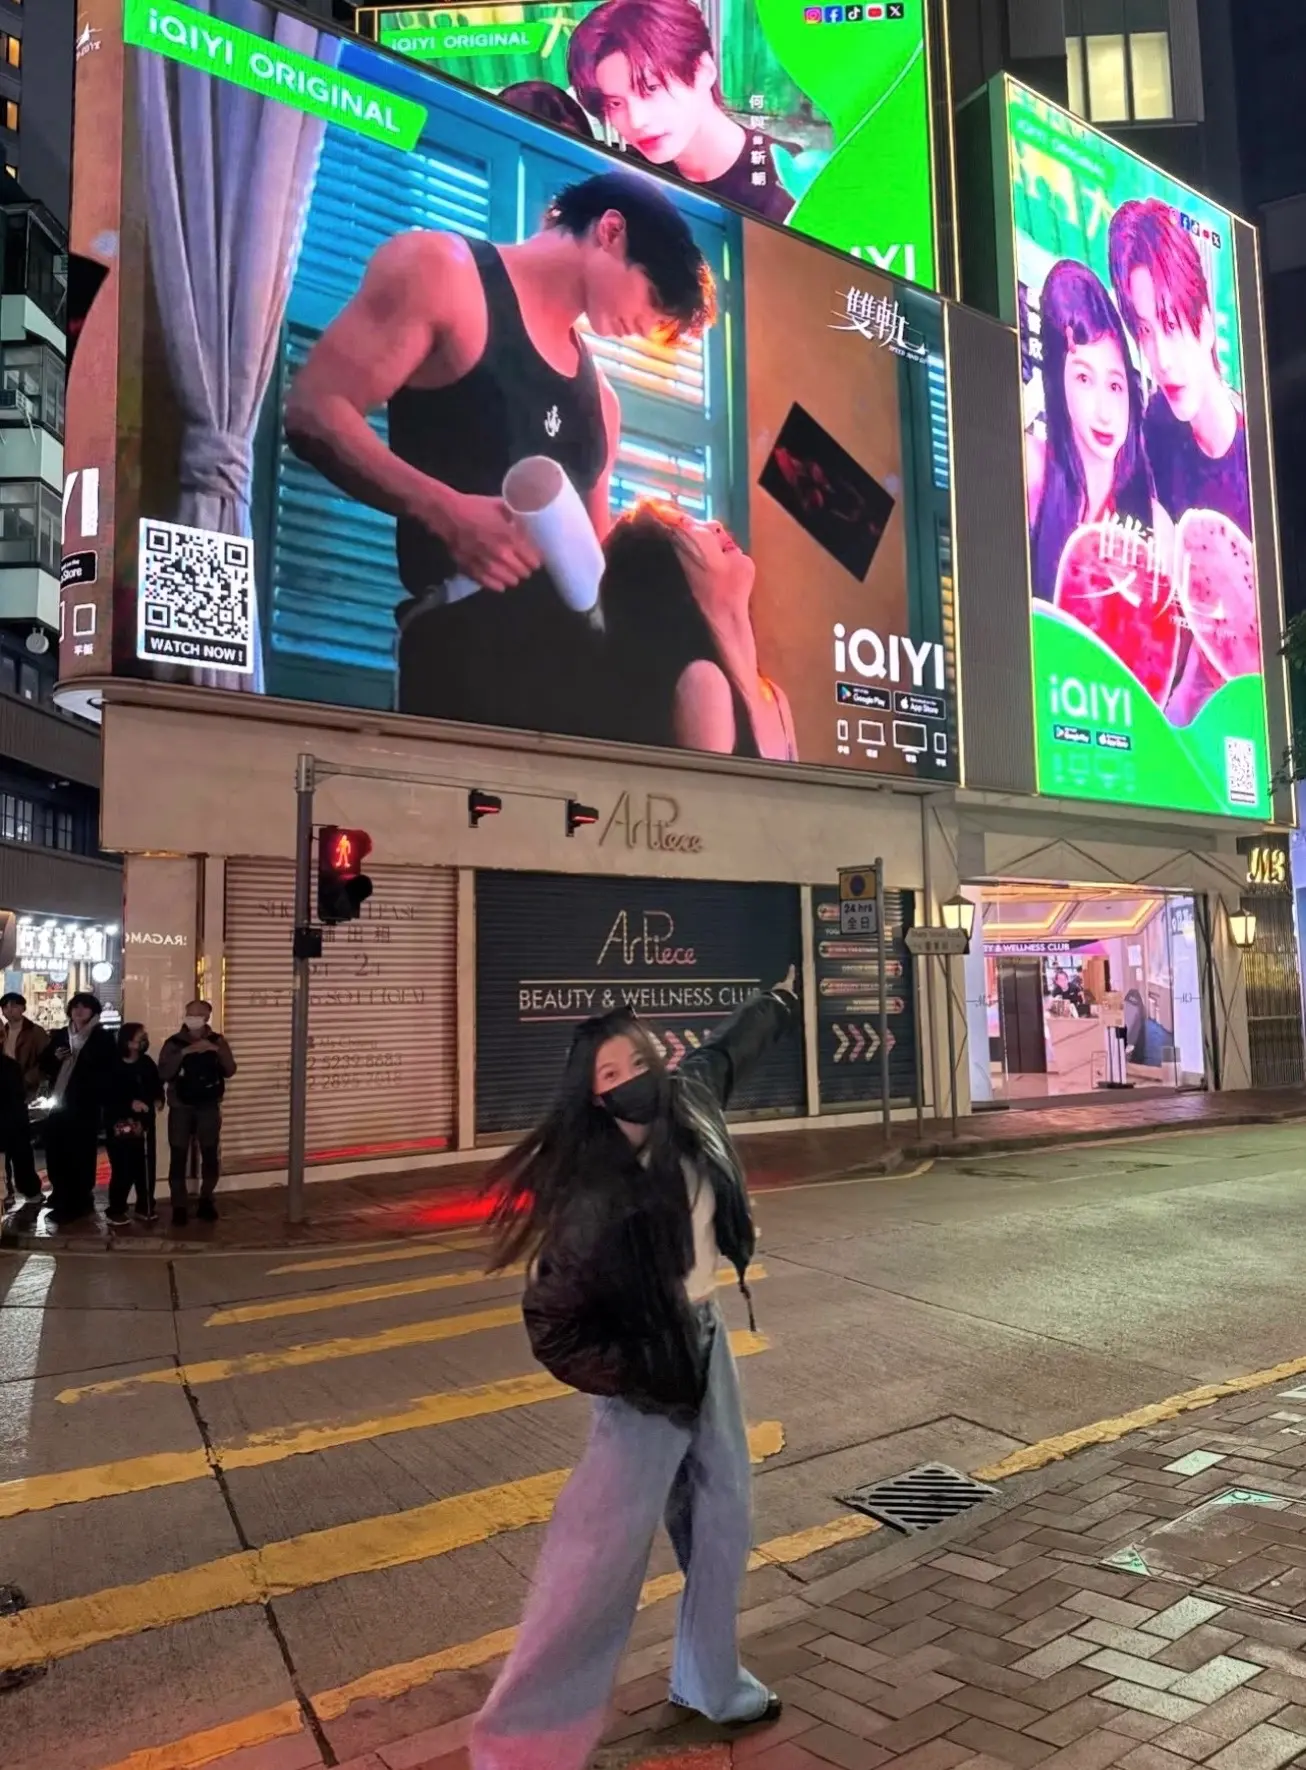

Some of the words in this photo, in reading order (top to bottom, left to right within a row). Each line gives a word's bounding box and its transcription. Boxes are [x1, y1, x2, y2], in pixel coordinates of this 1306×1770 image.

[391, 37, 435, 50] iQIYI
[443, 32, 530, 49] ORIGINAL
[148, 8, 233, 65] iQIYI
[250, 52, 400, 133] ORIGINAL
[150, 636, 200, 656] WATCH
[203, 645, 236, 661] NOW
[238, 650, 243, 662] !
[833, 622, 945, 690] iQIYI
[852, 693, 874, 705] Google
[1050, 673, 1132, 728] iQIYI
[844, 903, 857, 913] 24
[858, 903, 873, 913] hrs
[1003, 943, 1046, 952] WELLNESS
[1047, 943, 1070, 951] CLUB
[519, 989, 595, 1011] BEAUTY
[602, 989, 615, 1008] &
[621, 988, 713, 1007] WELLNESS
